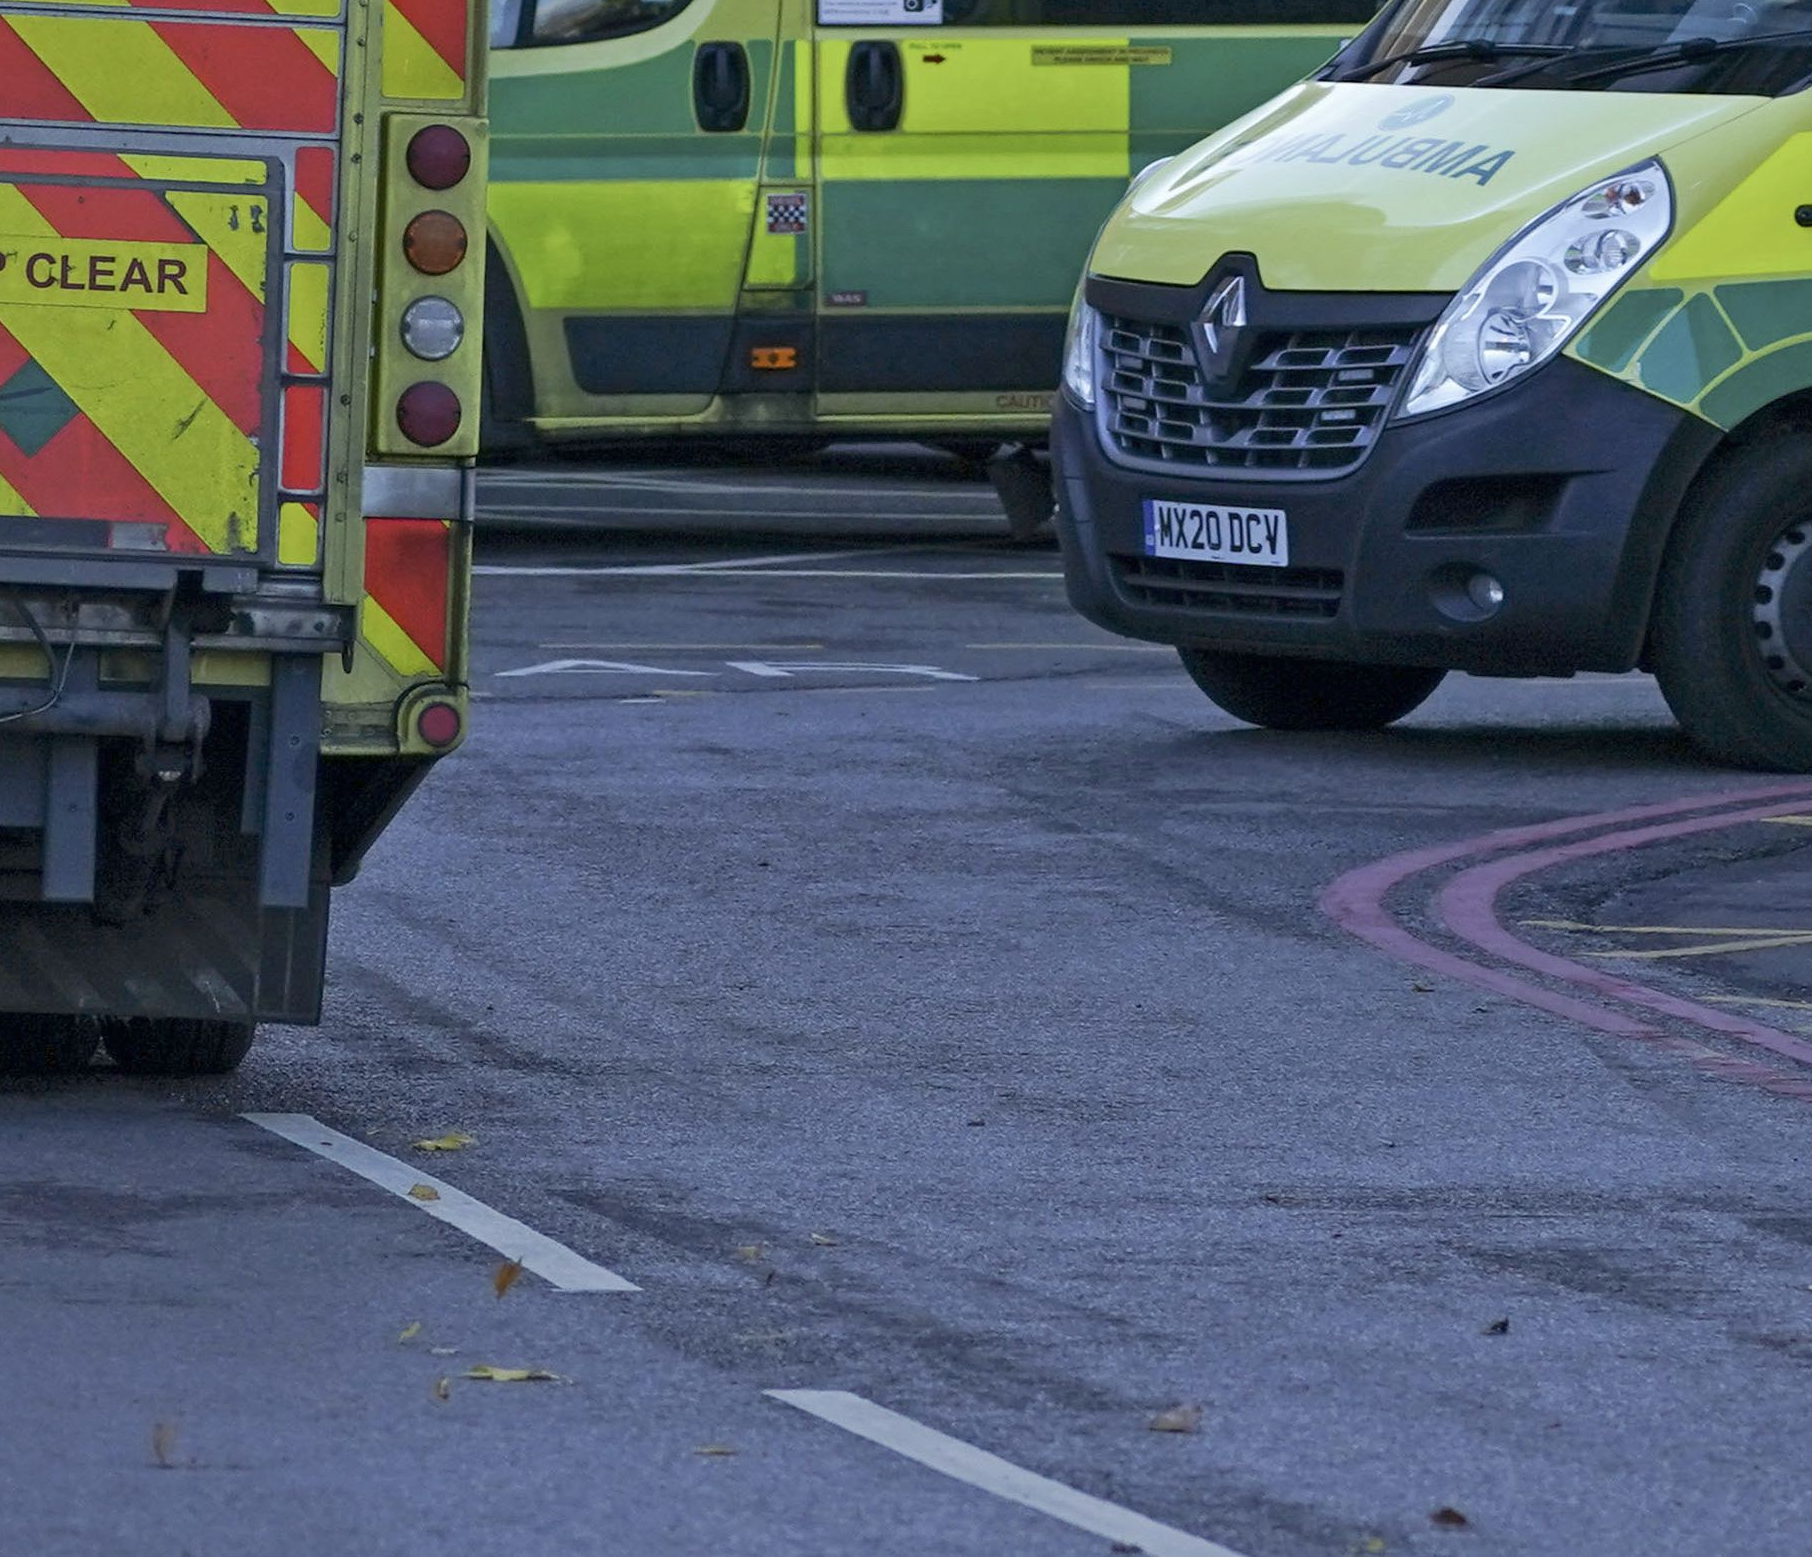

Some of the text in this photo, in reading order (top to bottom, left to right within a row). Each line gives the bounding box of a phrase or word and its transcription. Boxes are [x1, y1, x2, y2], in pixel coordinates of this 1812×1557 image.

[24, 251, 190, 296] CLEAR
[1158, 505, 1280, 556] MX20 DCV
